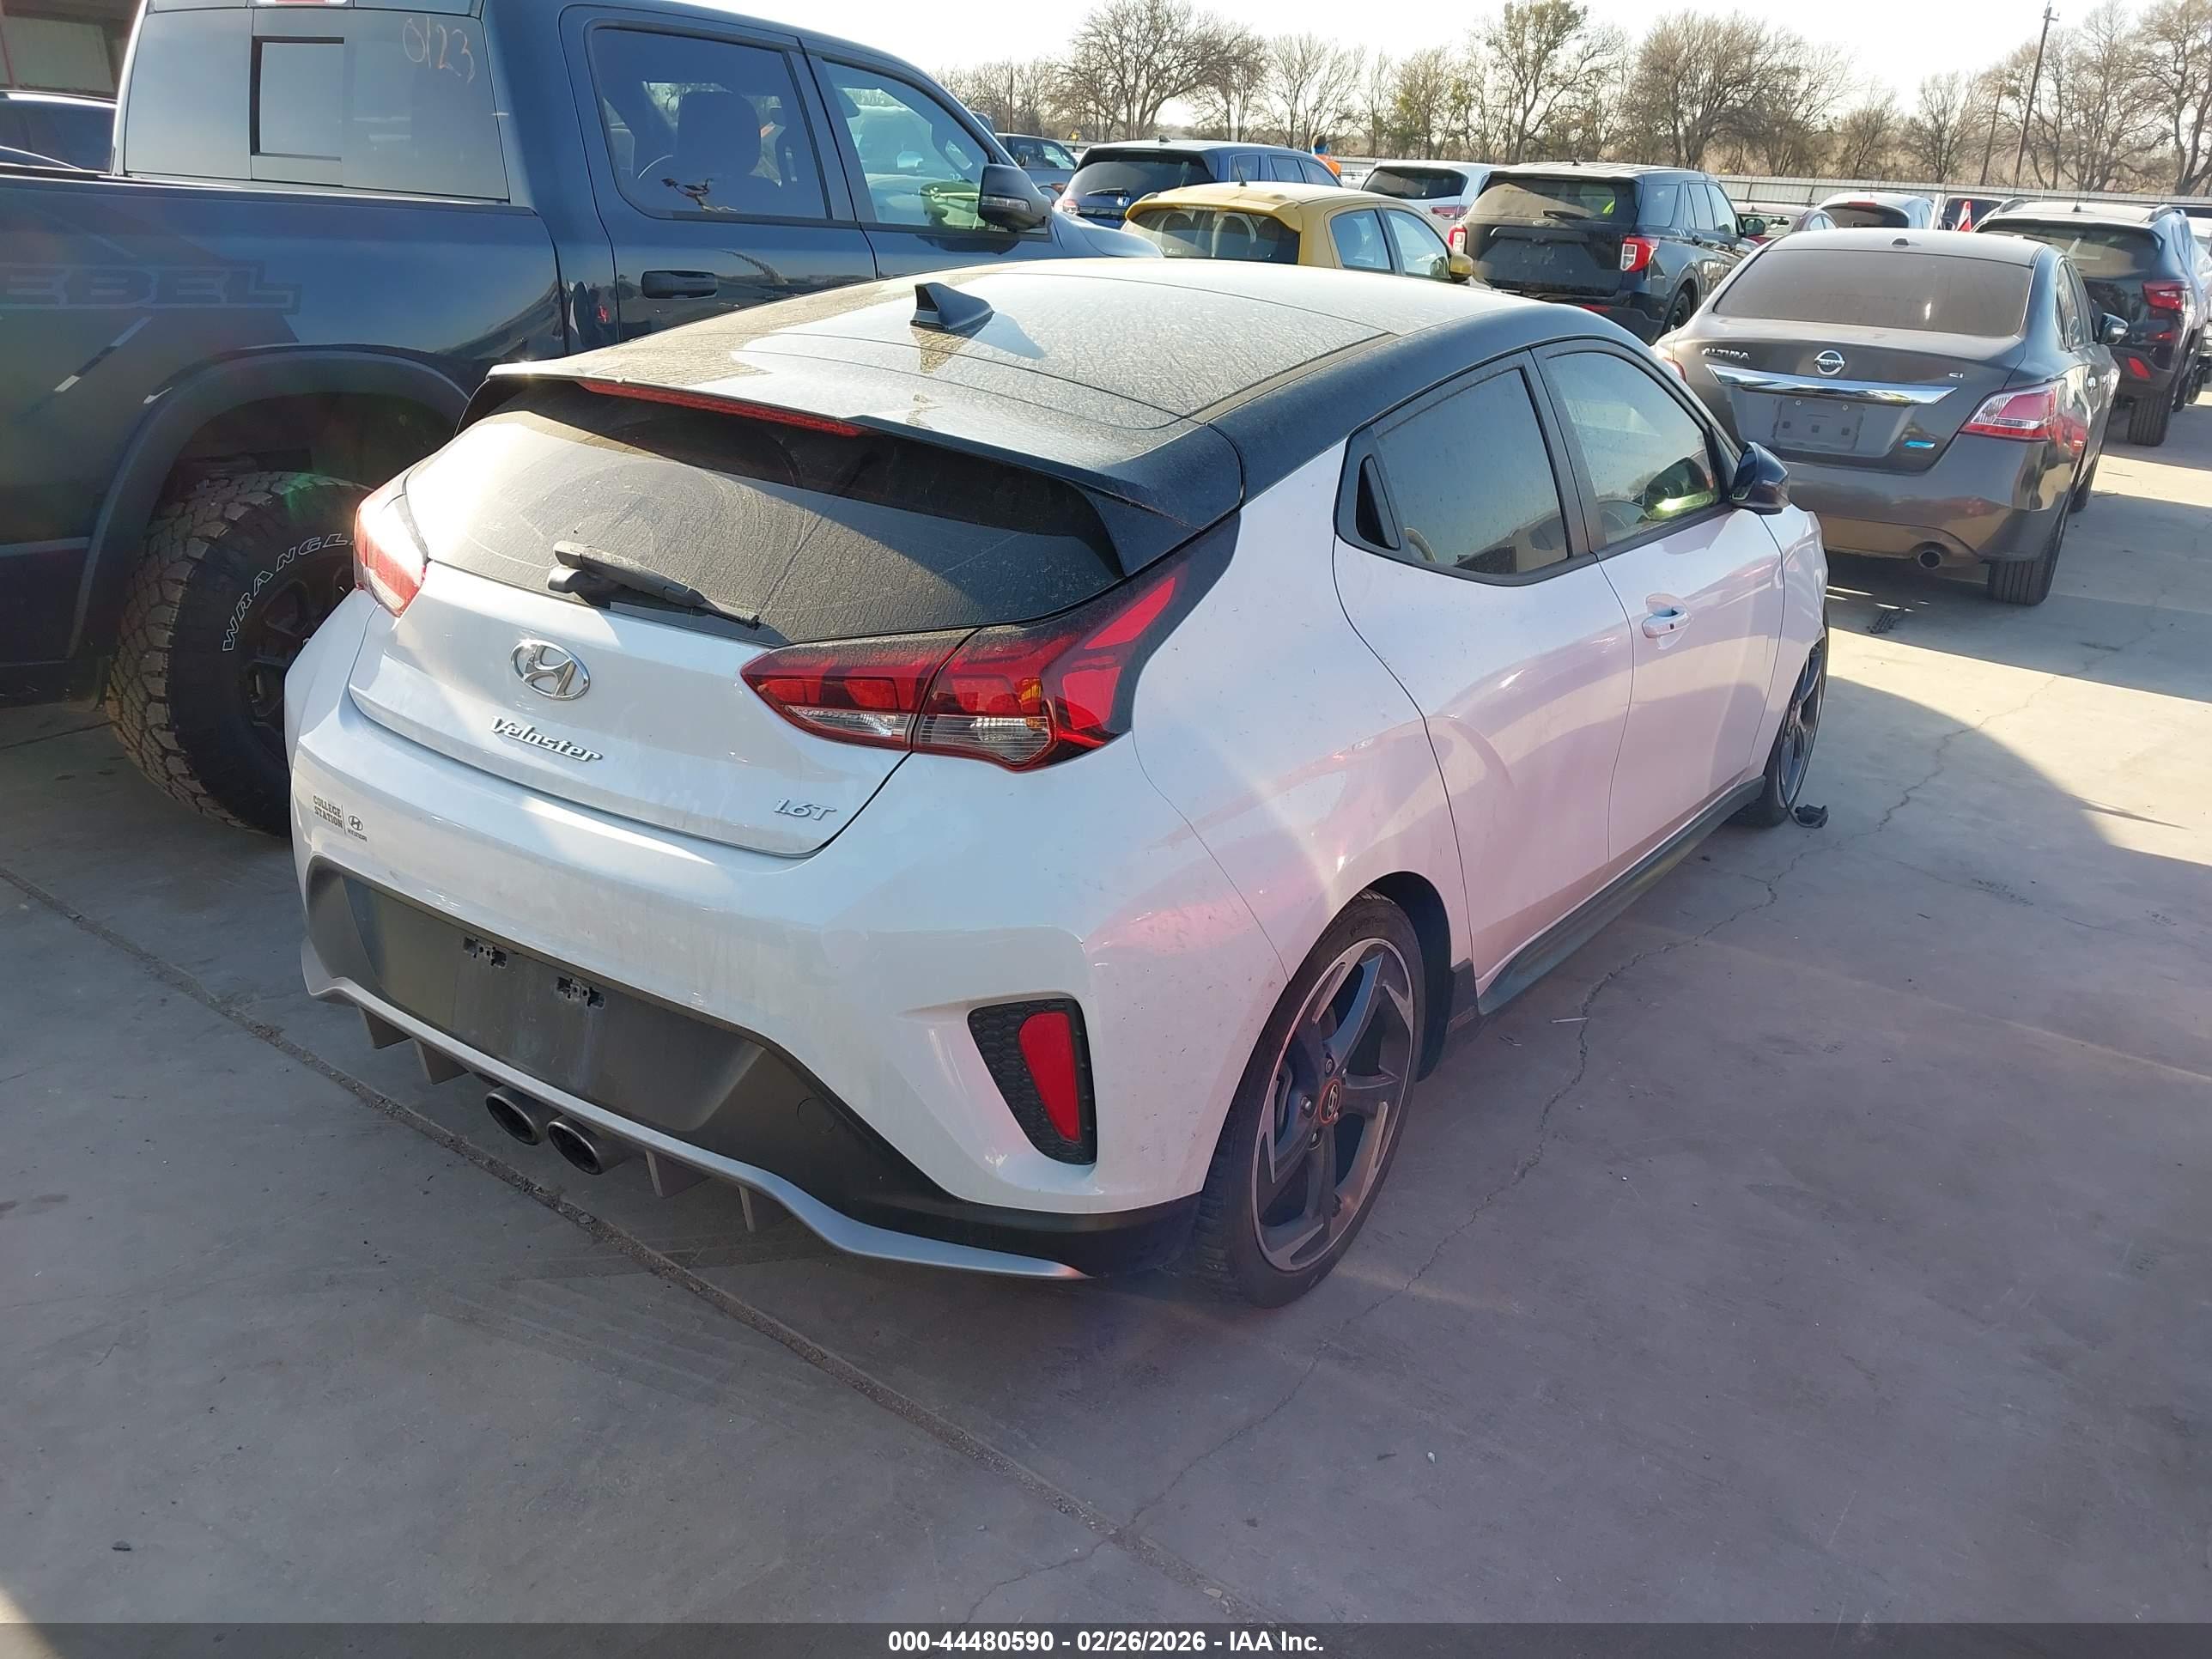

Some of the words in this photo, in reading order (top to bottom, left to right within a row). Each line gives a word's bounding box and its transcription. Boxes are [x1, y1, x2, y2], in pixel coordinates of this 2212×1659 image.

[1701, 347, 1751, 360] ALTIMA
[222, 533, 355, 651] WRANGL
[490, 715, 604, 762] Veloster
[313, 795, 342, 818] COLLEGE
[314, 805, 343, 830] STATION
